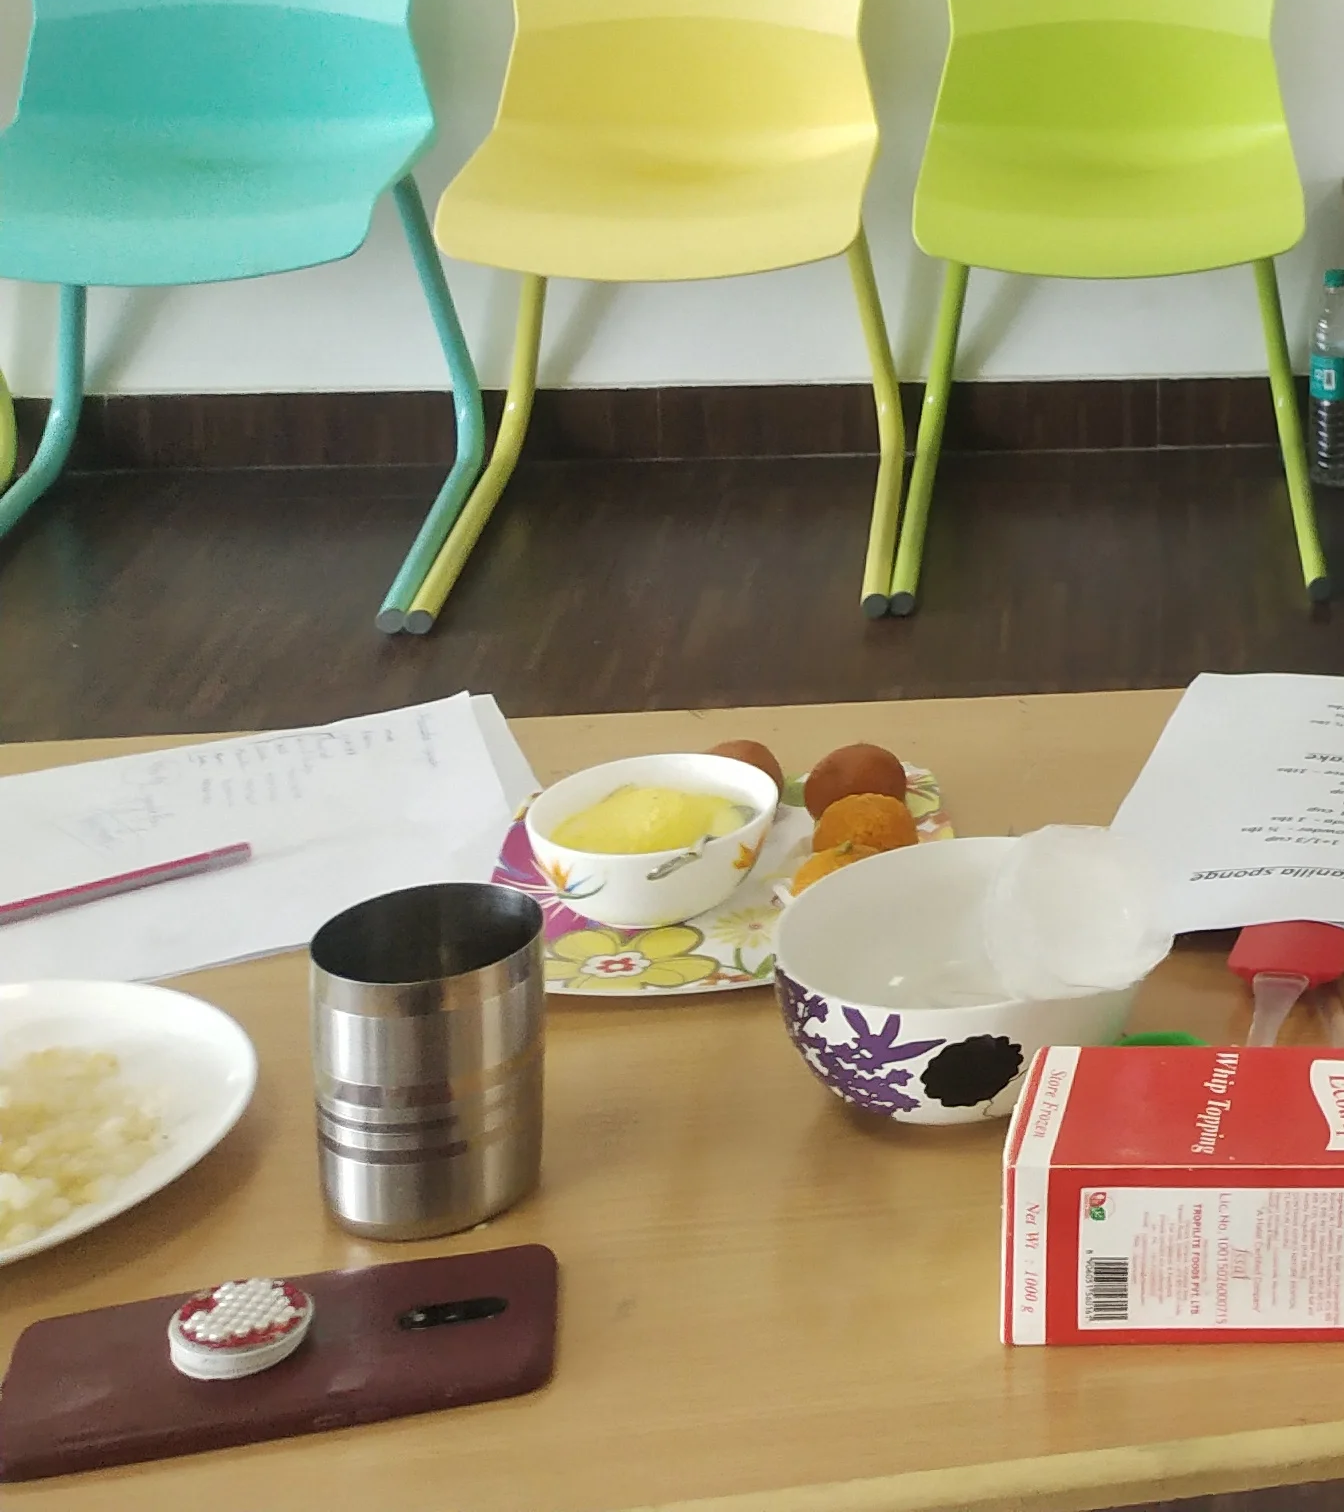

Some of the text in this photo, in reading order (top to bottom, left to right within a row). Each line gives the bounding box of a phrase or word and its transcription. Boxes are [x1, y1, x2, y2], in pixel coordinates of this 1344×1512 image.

[1189, 868, 1273, 883] sponge
[1033, 1069, 1067, 1139] Store Frozen
[1190, 1052, 1240, 1155] Whip Topping
[1024, 1202, 1040, 1225] Net
[1025, 1232, 1039, 1249] Wt
[1191, 1253, 1201, 1279] FOODS
[1024, 1270, 1039, 1302] 1000
[1021, 1304, 1035, 1313] g
